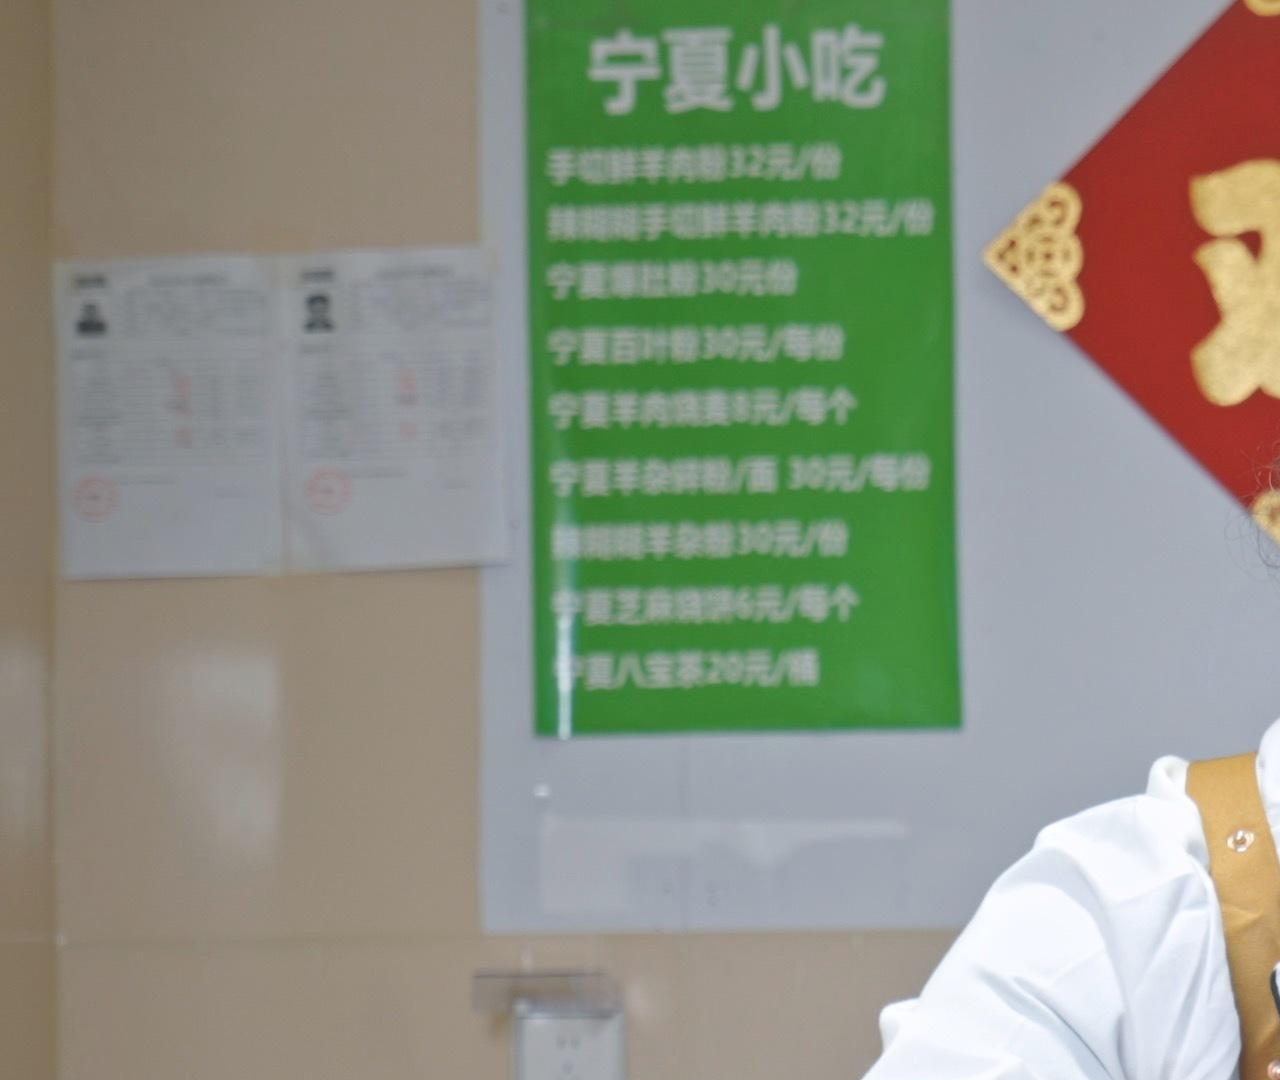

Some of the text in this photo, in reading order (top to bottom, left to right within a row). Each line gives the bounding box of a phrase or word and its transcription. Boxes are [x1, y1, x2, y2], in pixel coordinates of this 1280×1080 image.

[589, 23, 887, 115] 宁夏小吃
[790, 453, 931, 492] 30元/每份
